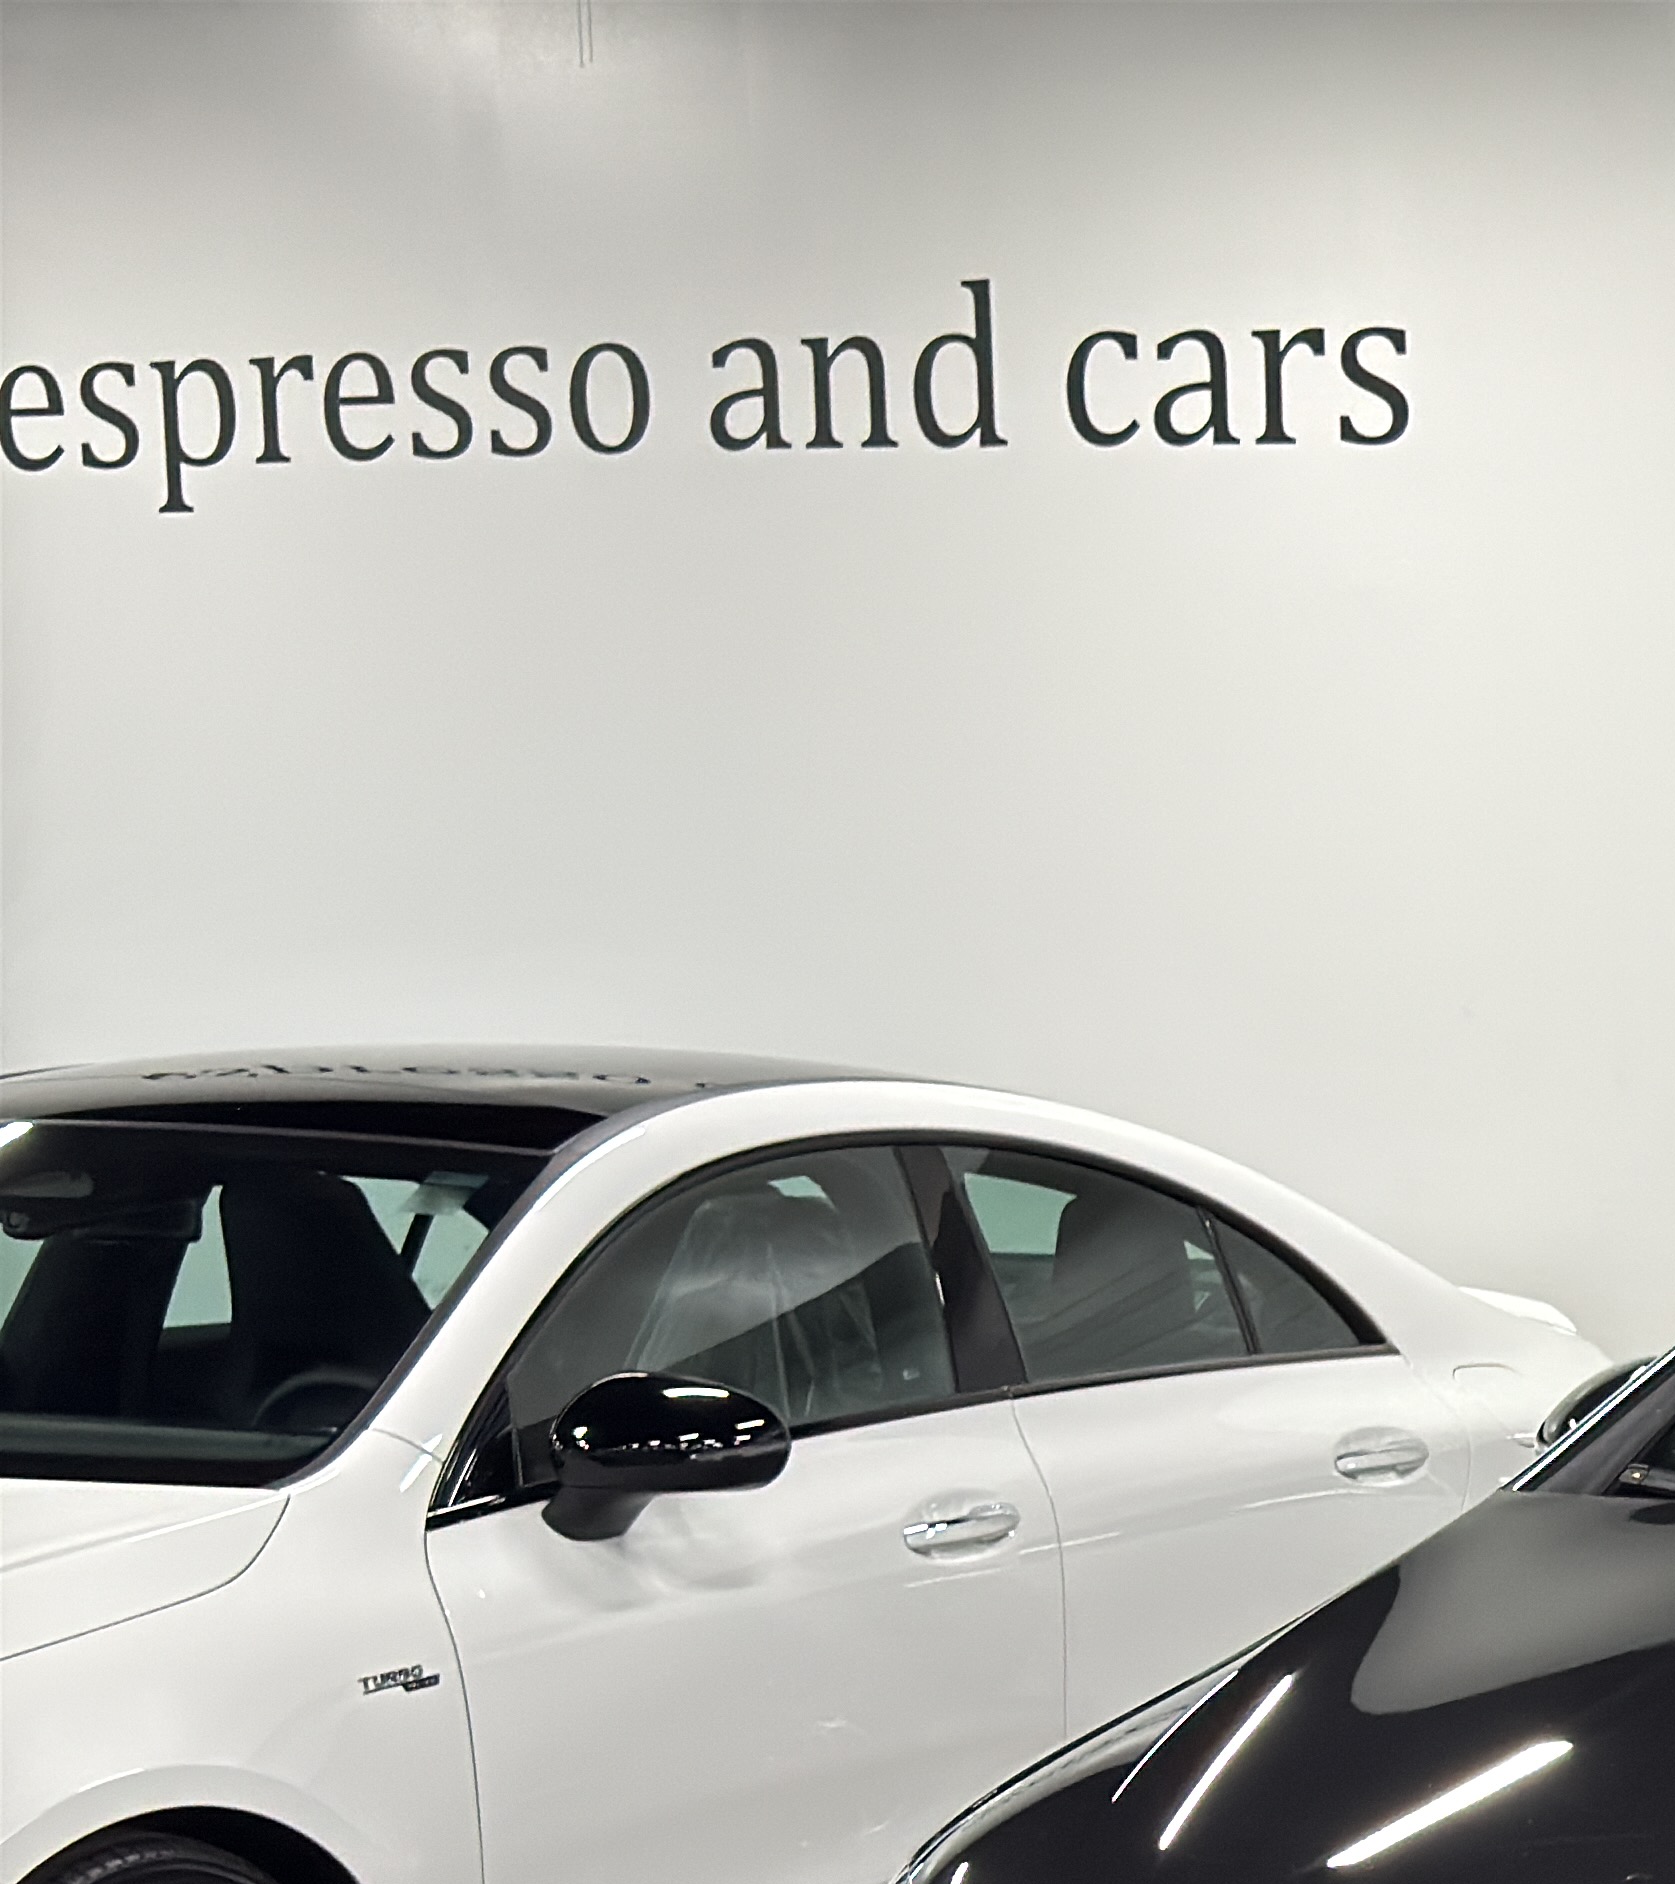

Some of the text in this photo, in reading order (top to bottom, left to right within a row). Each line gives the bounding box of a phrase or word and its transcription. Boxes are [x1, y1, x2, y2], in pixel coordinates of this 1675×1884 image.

[0, 277, 1410, 515] espresso and cars
